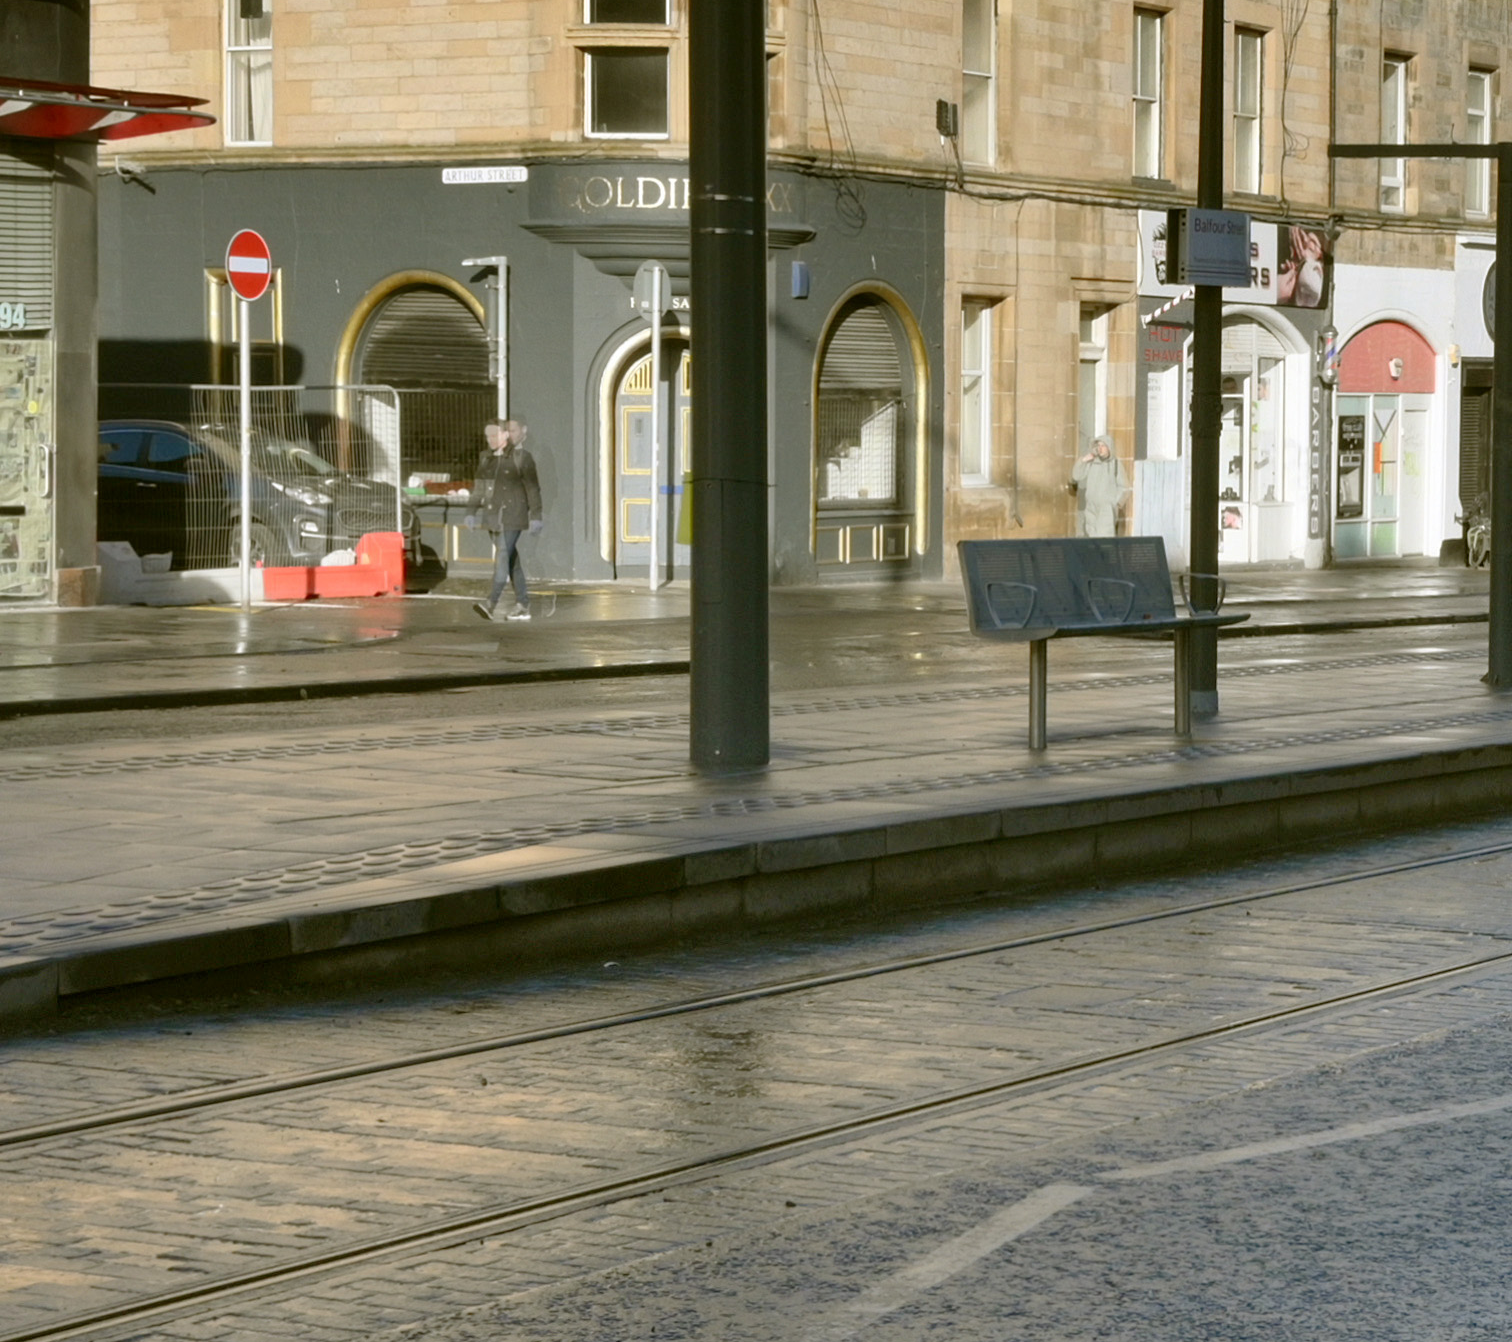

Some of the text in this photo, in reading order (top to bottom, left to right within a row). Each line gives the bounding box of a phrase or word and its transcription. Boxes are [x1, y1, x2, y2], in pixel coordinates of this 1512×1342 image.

[445, 169, 524, 181] ARTHUR STREET
[1194, 218, 1226, 234] Balfour
[1311, 385, 1320, 535] BARBERS
